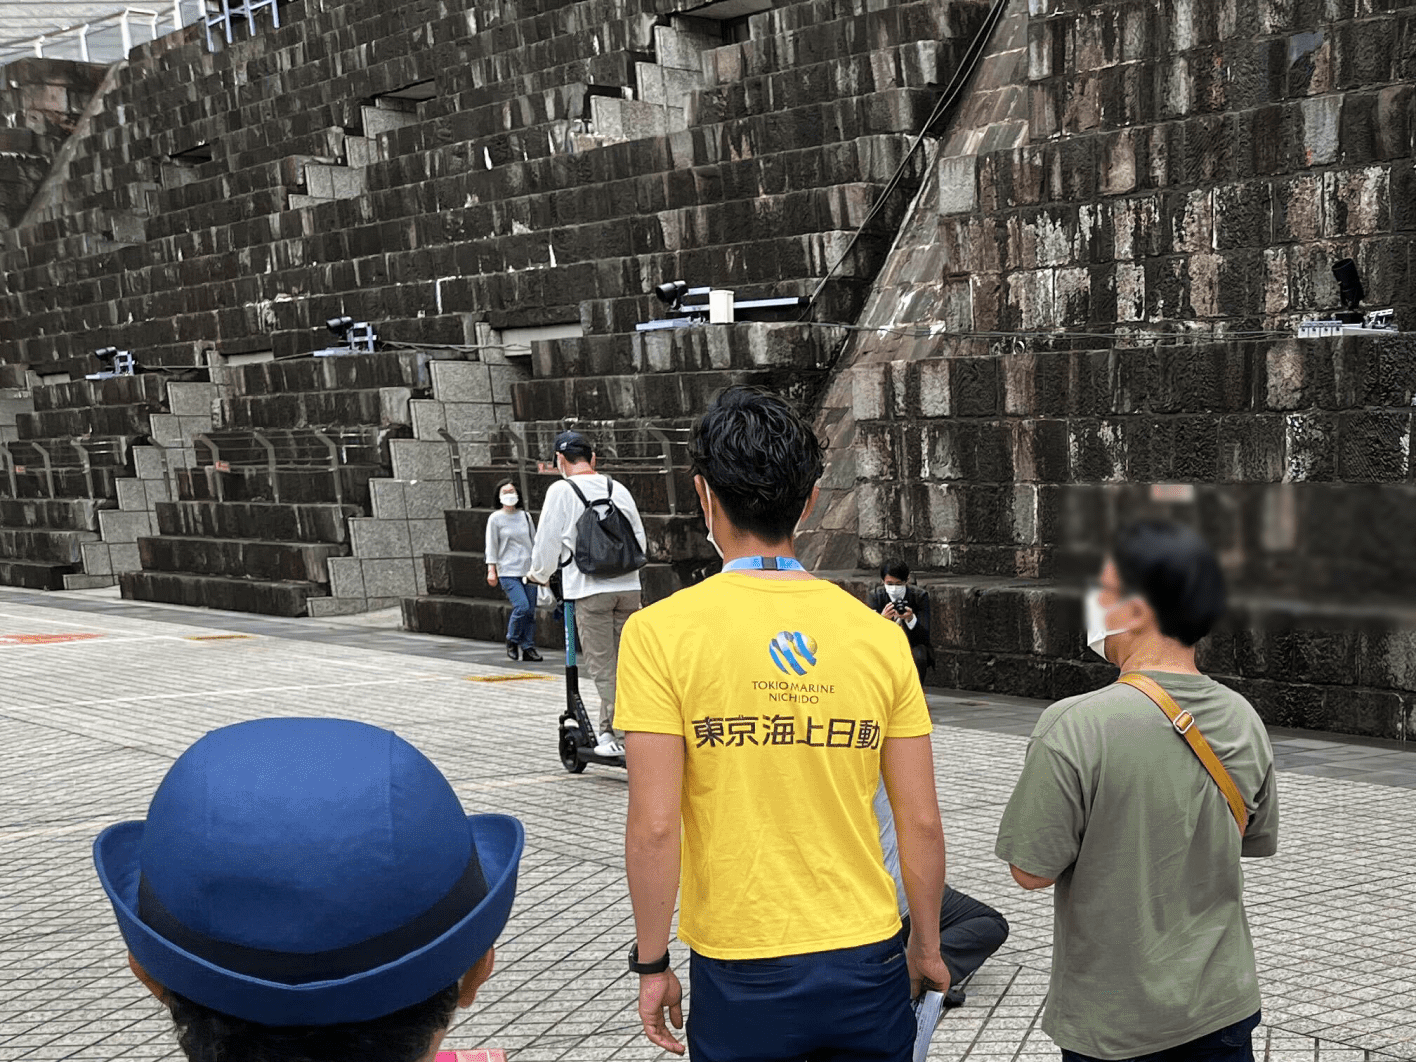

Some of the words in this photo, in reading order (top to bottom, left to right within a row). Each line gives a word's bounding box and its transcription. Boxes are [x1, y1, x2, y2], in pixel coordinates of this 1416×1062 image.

[751, 680, 790, 691] TOKIO
[790, 681, 836, 694] MARINE
[768, 692, 820, 705] NICHIDO
[691, 714, 881, 750] 東京海上日動
